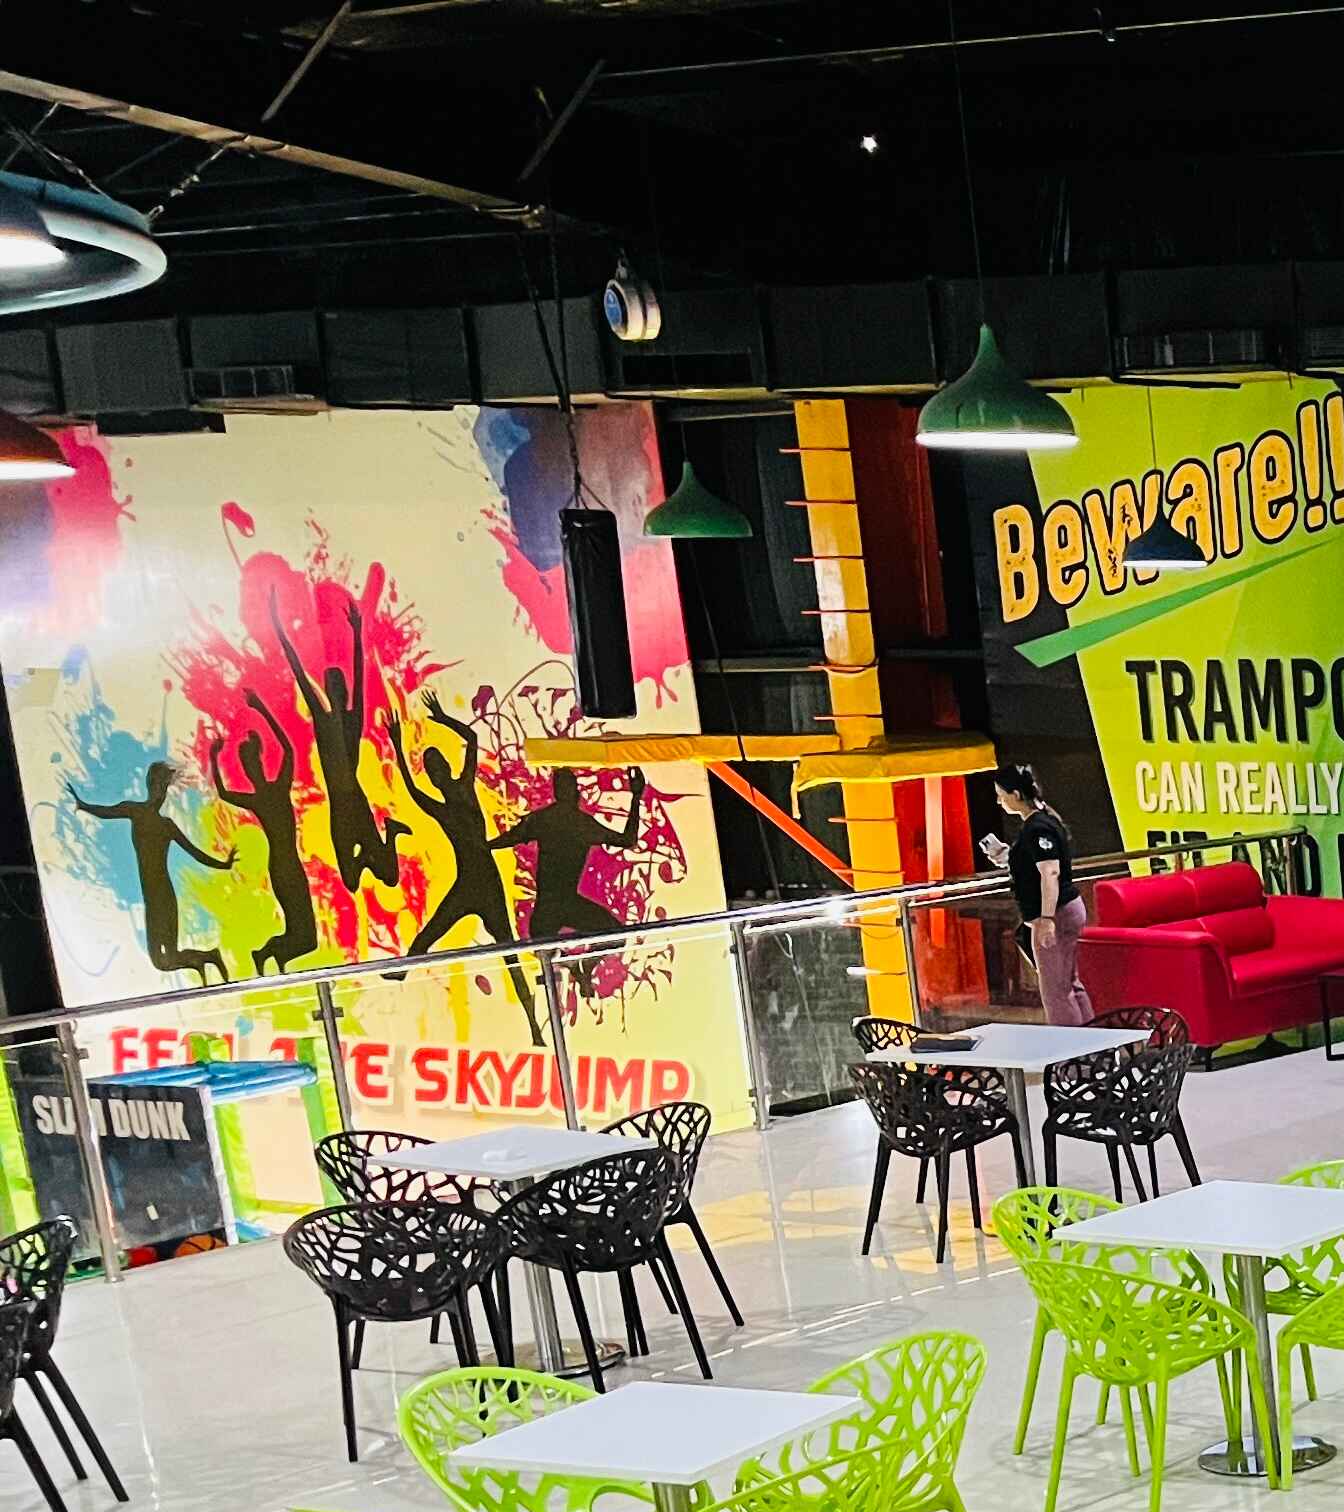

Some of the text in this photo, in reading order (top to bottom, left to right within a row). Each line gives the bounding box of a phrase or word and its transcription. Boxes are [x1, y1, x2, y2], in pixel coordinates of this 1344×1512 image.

[1135, 760, 1208, 815] CAN
[1215, 761, 1344, 816] REALLY
[108, 1098, 192, 1141] DUNK
